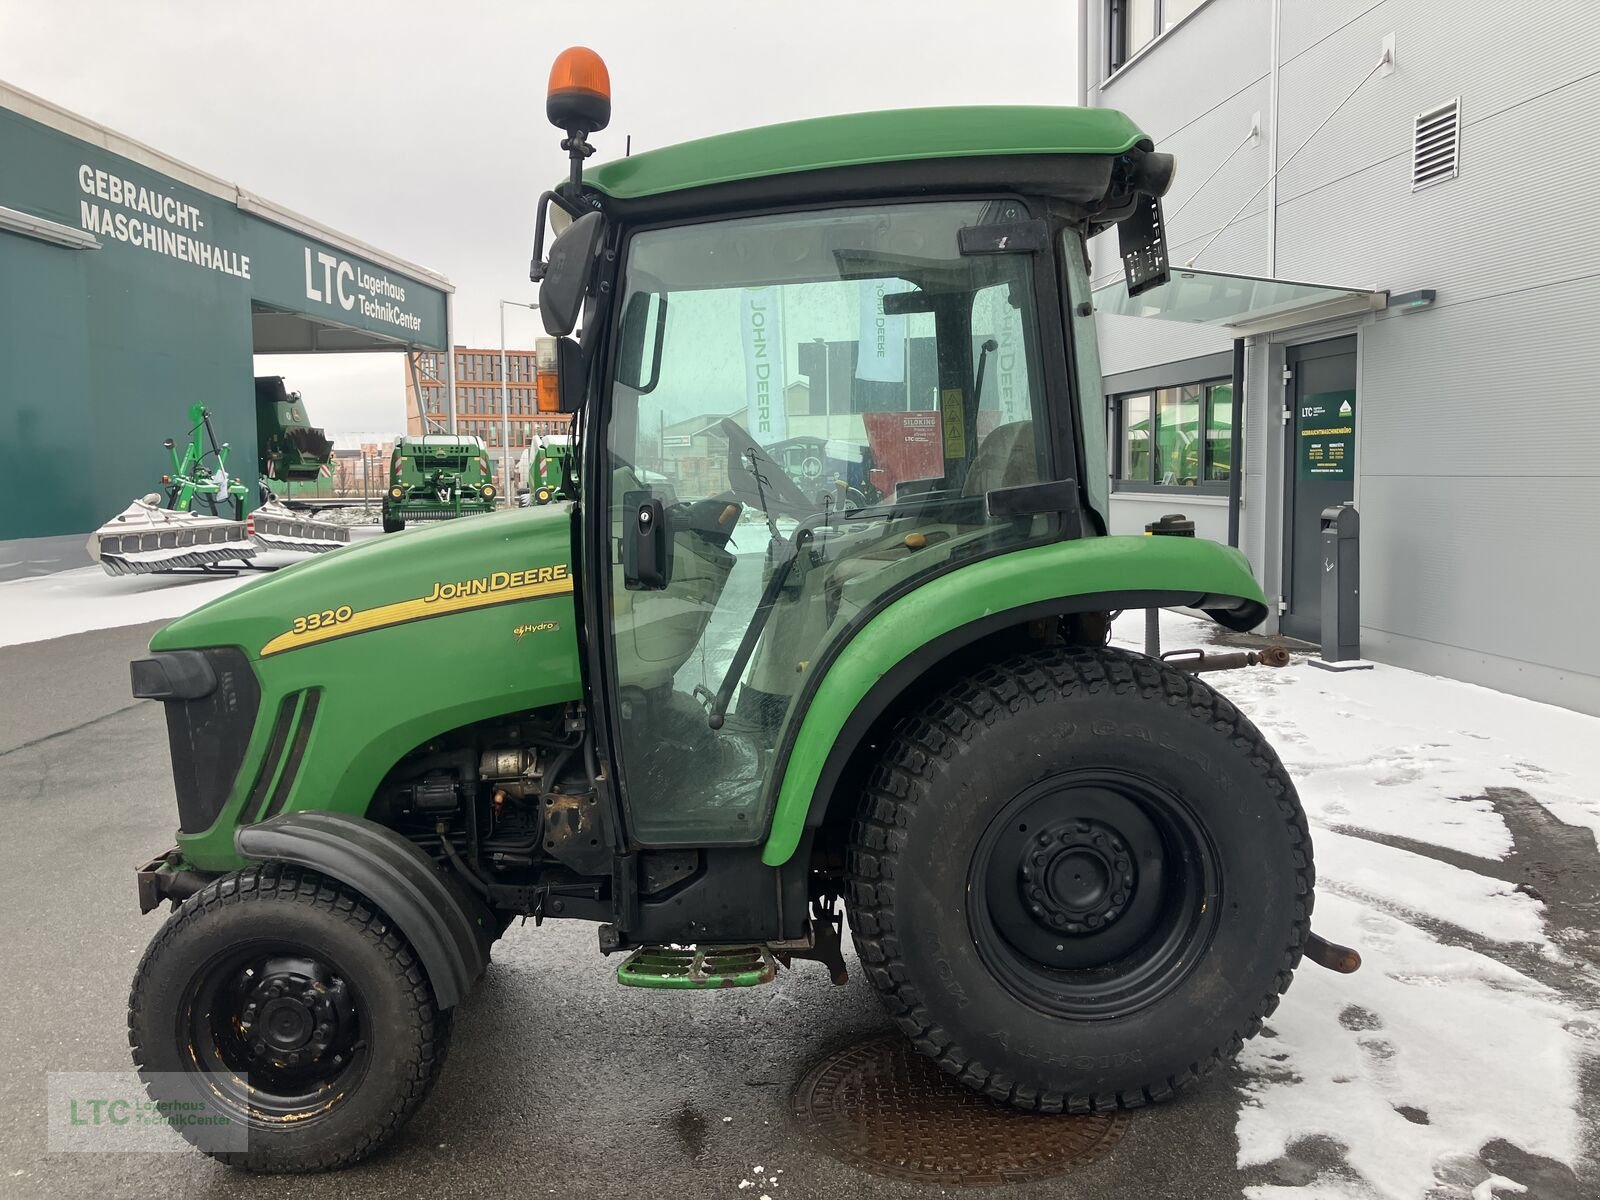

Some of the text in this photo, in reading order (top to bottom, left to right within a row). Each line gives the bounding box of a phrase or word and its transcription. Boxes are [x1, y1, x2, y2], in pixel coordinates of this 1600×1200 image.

[79, 164, 204, 232] GEBRAUCHT-
[80, 200, 251, 280] MASCHINENHALLE
[304, 247, 355, 311] LTC
[357, 266, 406, 302] Lagerhaus
[358, 294, 421, 331] TechnikCenter
[750, 299, 771, 433] JOHN DEERE
[1301, 407, 1313, 417] LTC
[424, 564, 568, 602] JOHN DEERE
[293, 605, 353, 634] 3320
